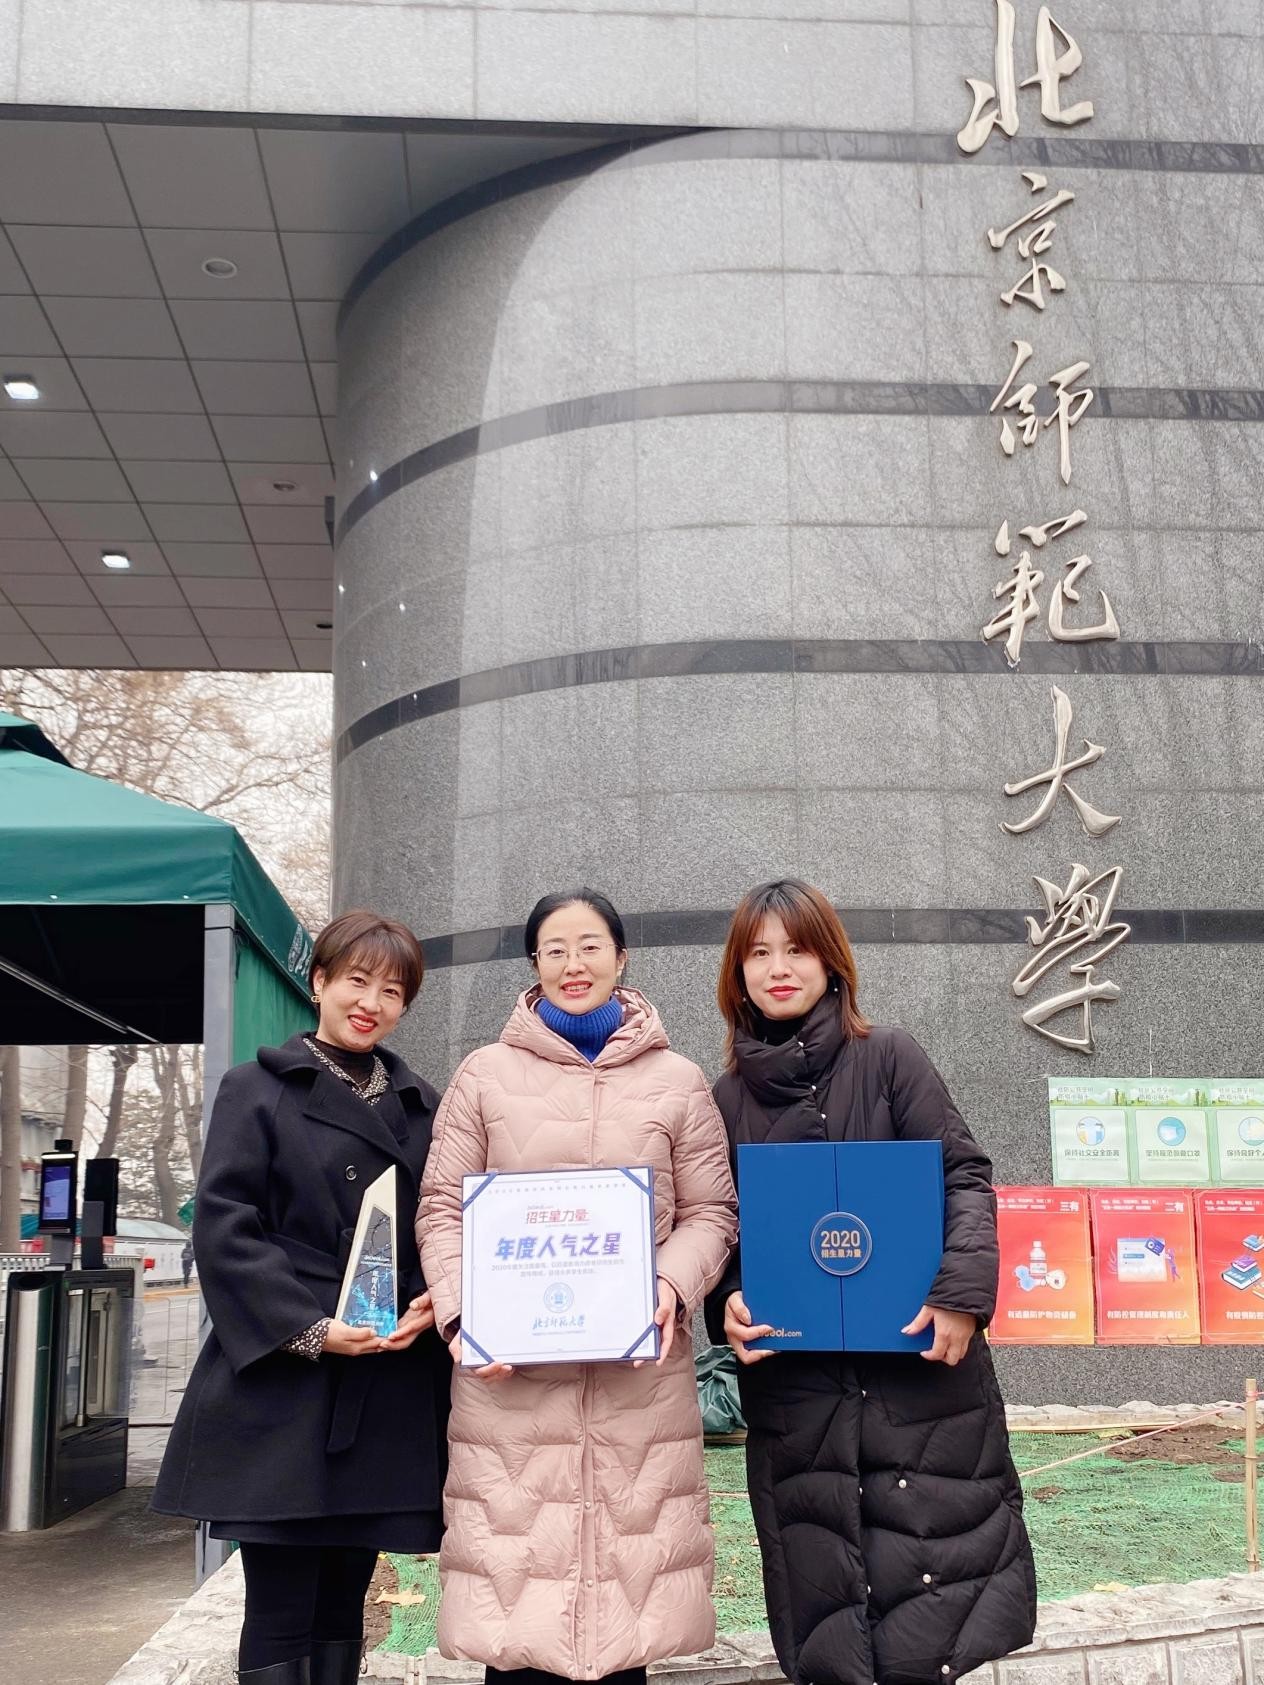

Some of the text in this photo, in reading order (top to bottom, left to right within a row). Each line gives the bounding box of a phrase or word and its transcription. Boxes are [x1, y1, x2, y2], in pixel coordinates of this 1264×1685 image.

[494, 1231, 622, 1261] 年度人气之星
[820, 1230, 861, 1248] 2020
